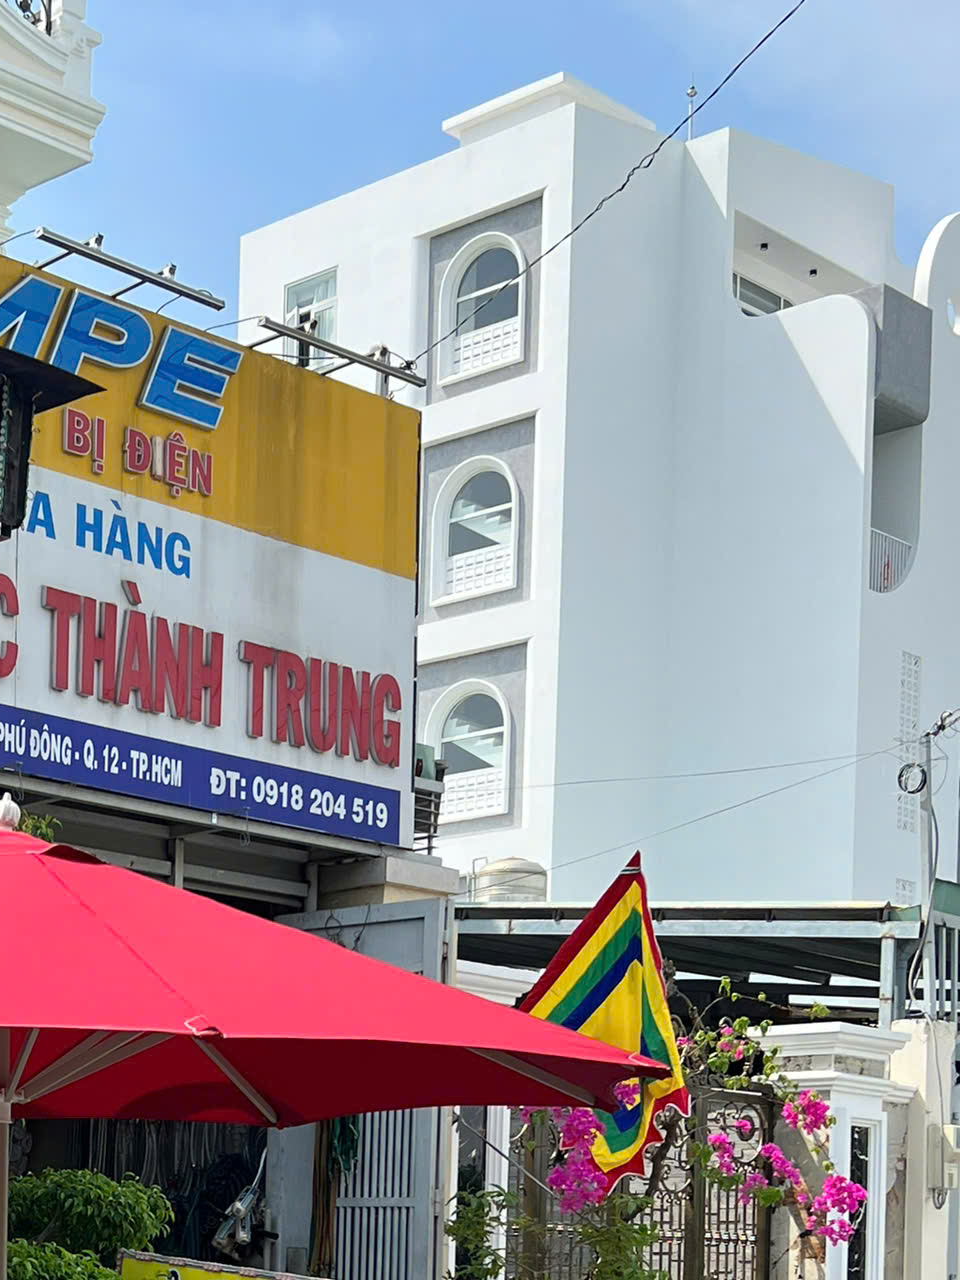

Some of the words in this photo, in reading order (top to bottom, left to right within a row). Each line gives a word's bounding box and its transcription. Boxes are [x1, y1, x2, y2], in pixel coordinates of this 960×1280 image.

[63, 406, 106, 474] BỊ
[123, 426, 213, 497] ĐIỆN
[75, 498, 191, 579] HÀNG
[41, 580, 224, 727] THÀNH
[239, 640, 402, 767] TRUNG
[29, 725, 72, 765] ĐÔNG
[83, 739, 98, 769] Q.
[102, 744, 119, 774] 12
[130, 750, 182, 788] TP.HCM
[210, 768, 246, 800] ĐT:
[252, 776, 303, 811] 0918
[309, 788, 346, 820] 204
[352, 798, 388, 828] 519
